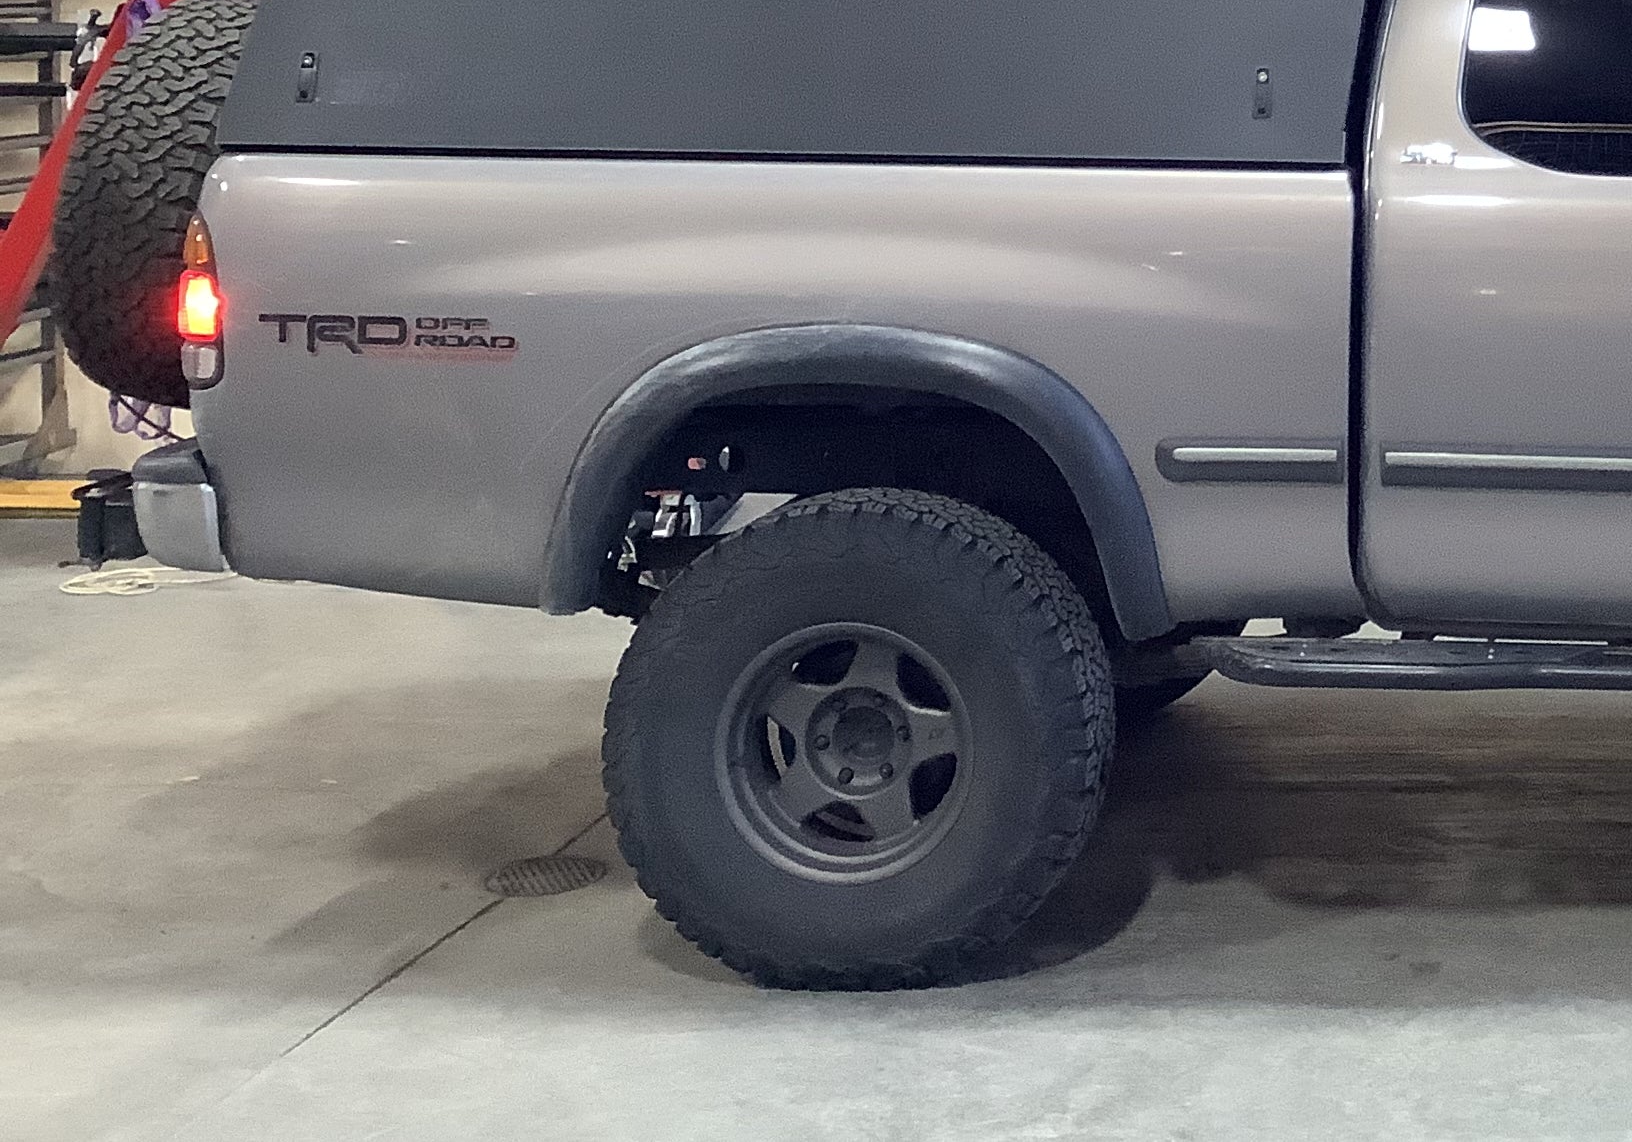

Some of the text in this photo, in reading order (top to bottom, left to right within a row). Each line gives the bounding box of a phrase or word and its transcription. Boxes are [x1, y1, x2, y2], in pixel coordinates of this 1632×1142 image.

[415, 316, 489, 331] OFF
[258, 313, 409, 355] TRD
[414, 334, 516, 349] ROAD
